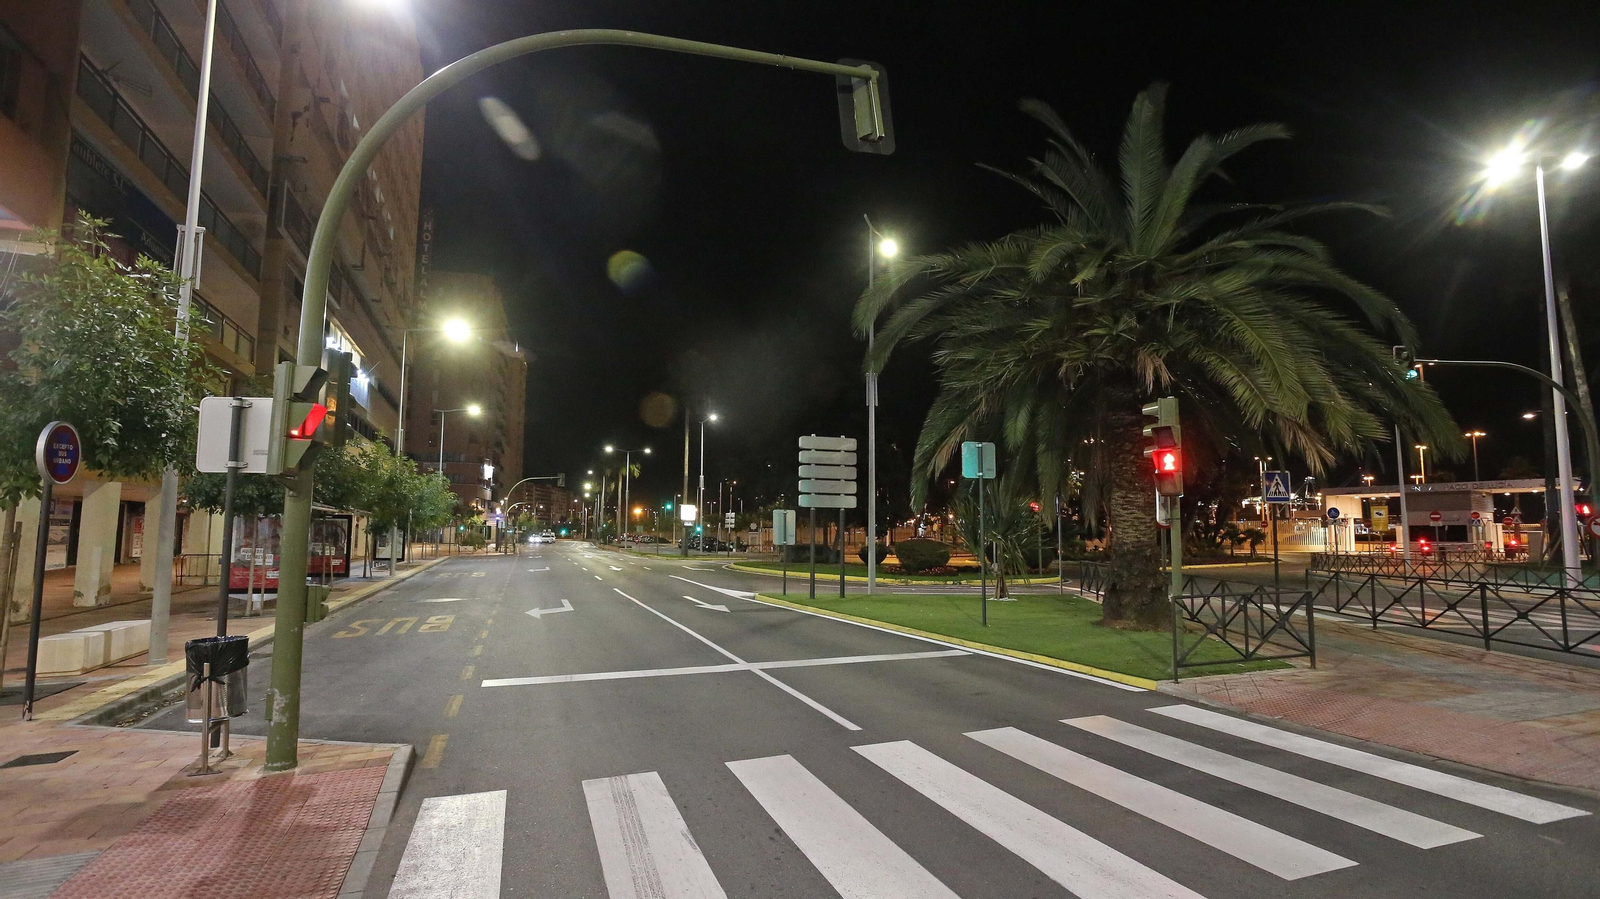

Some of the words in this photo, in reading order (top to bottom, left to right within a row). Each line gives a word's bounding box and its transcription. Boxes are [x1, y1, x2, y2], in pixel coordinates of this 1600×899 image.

[421, 222, 431, 274] HOTEL
[53, 443, 74, 451] EXCEPTO
[331, 614, 456, 639] BUS
